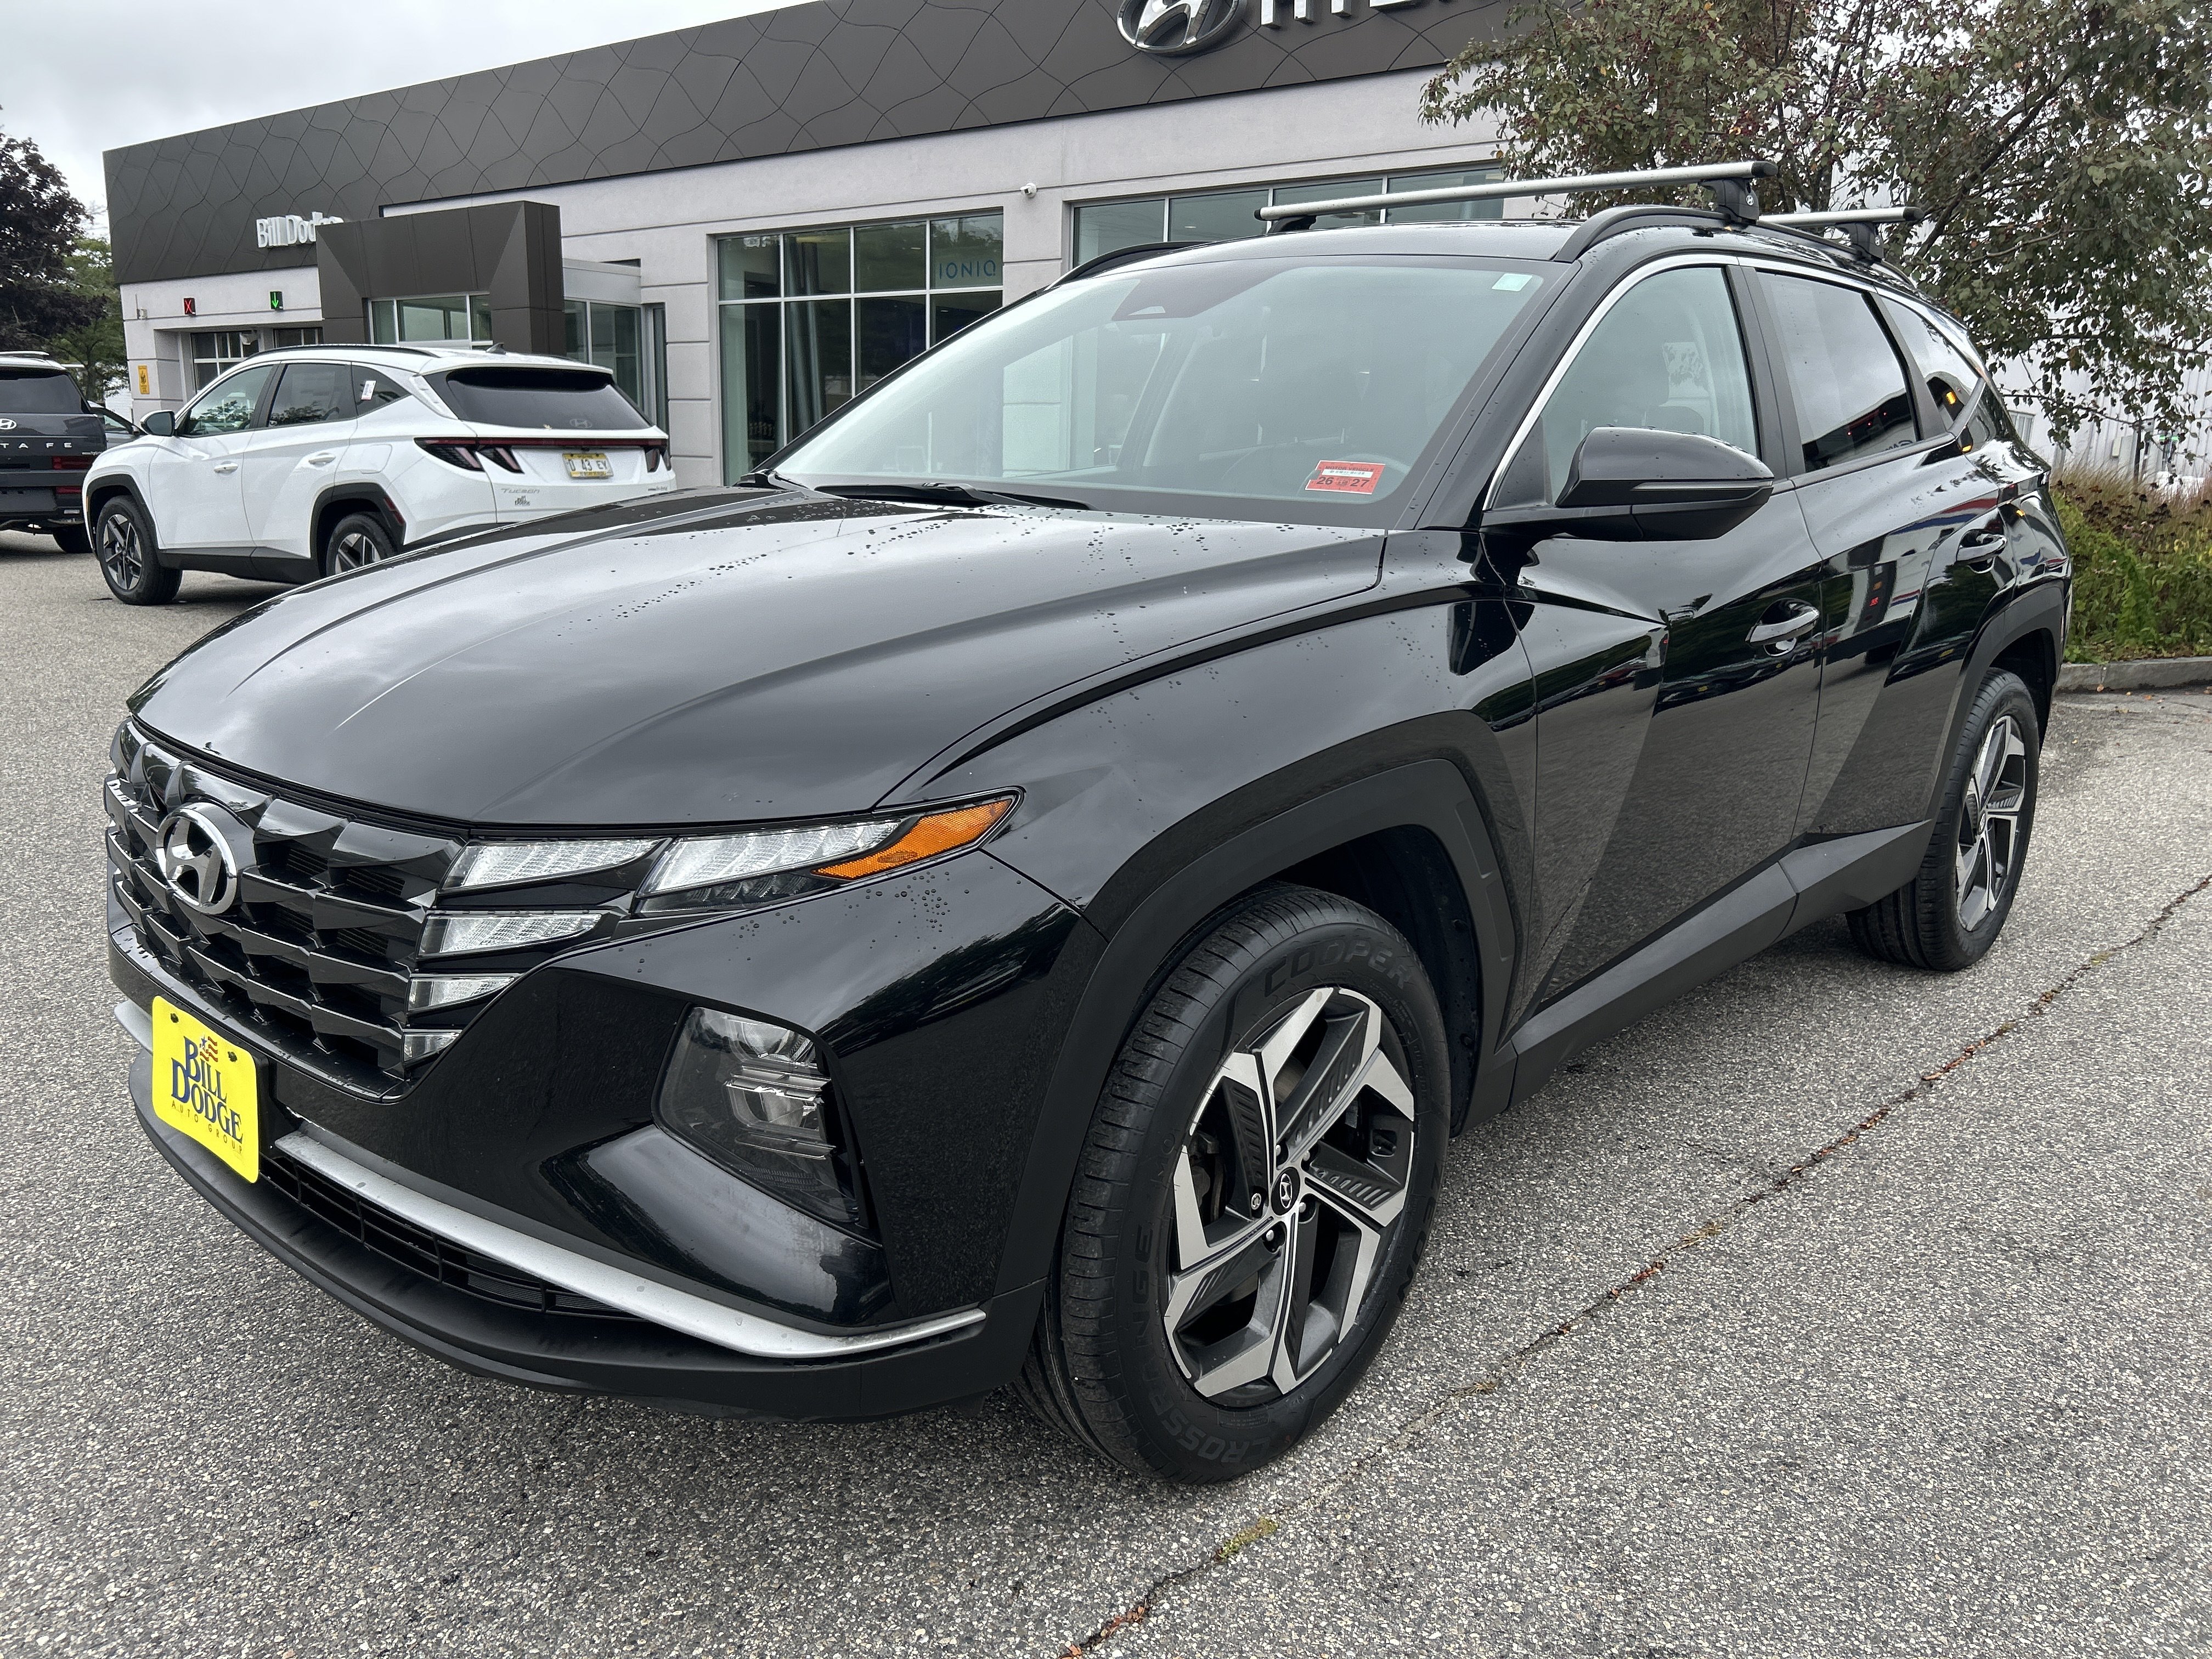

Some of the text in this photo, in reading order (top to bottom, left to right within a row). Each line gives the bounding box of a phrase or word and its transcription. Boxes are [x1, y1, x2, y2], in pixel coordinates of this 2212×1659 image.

[257, 212, 343, 247] Bill Dod
[939, 260, 996, 279] IONIQ
[1316, 476, 1370, 487] 26 27
[1265, 939, 1411, 997] COOPER
[183, 1036, 227, 1104] BILL
[171, 1057, 243, 1144] DODGE
[171, 1100, 242, 1154] AUTO GROUP
